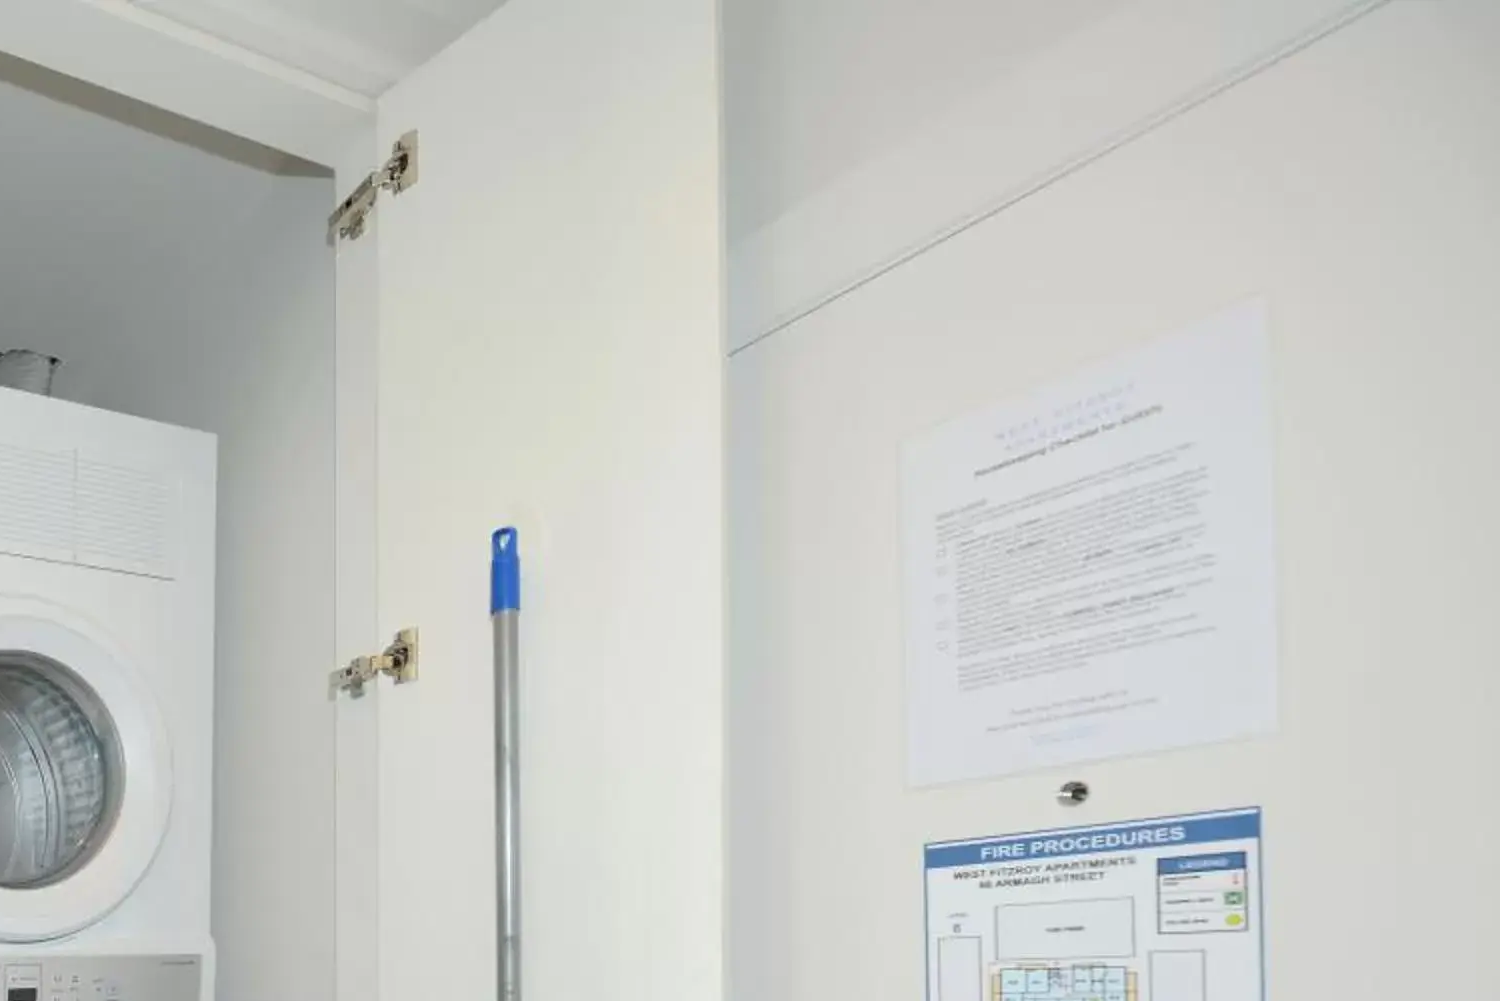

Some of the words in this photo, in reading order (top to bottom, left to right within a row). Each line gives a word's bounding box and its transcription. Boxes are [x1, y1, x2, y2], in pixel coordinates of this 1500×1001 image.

[981, 841, 1026, 860] FIRE
[1030, 826, 1186, 855] PROCEDURES
[953, 868, 985, 881] WEST
[989, 863, 1043, 877] FITZROY
[1044, 855, 1137, 872] APARTMENTS
[1053, 871, 1105, 883] STREET
